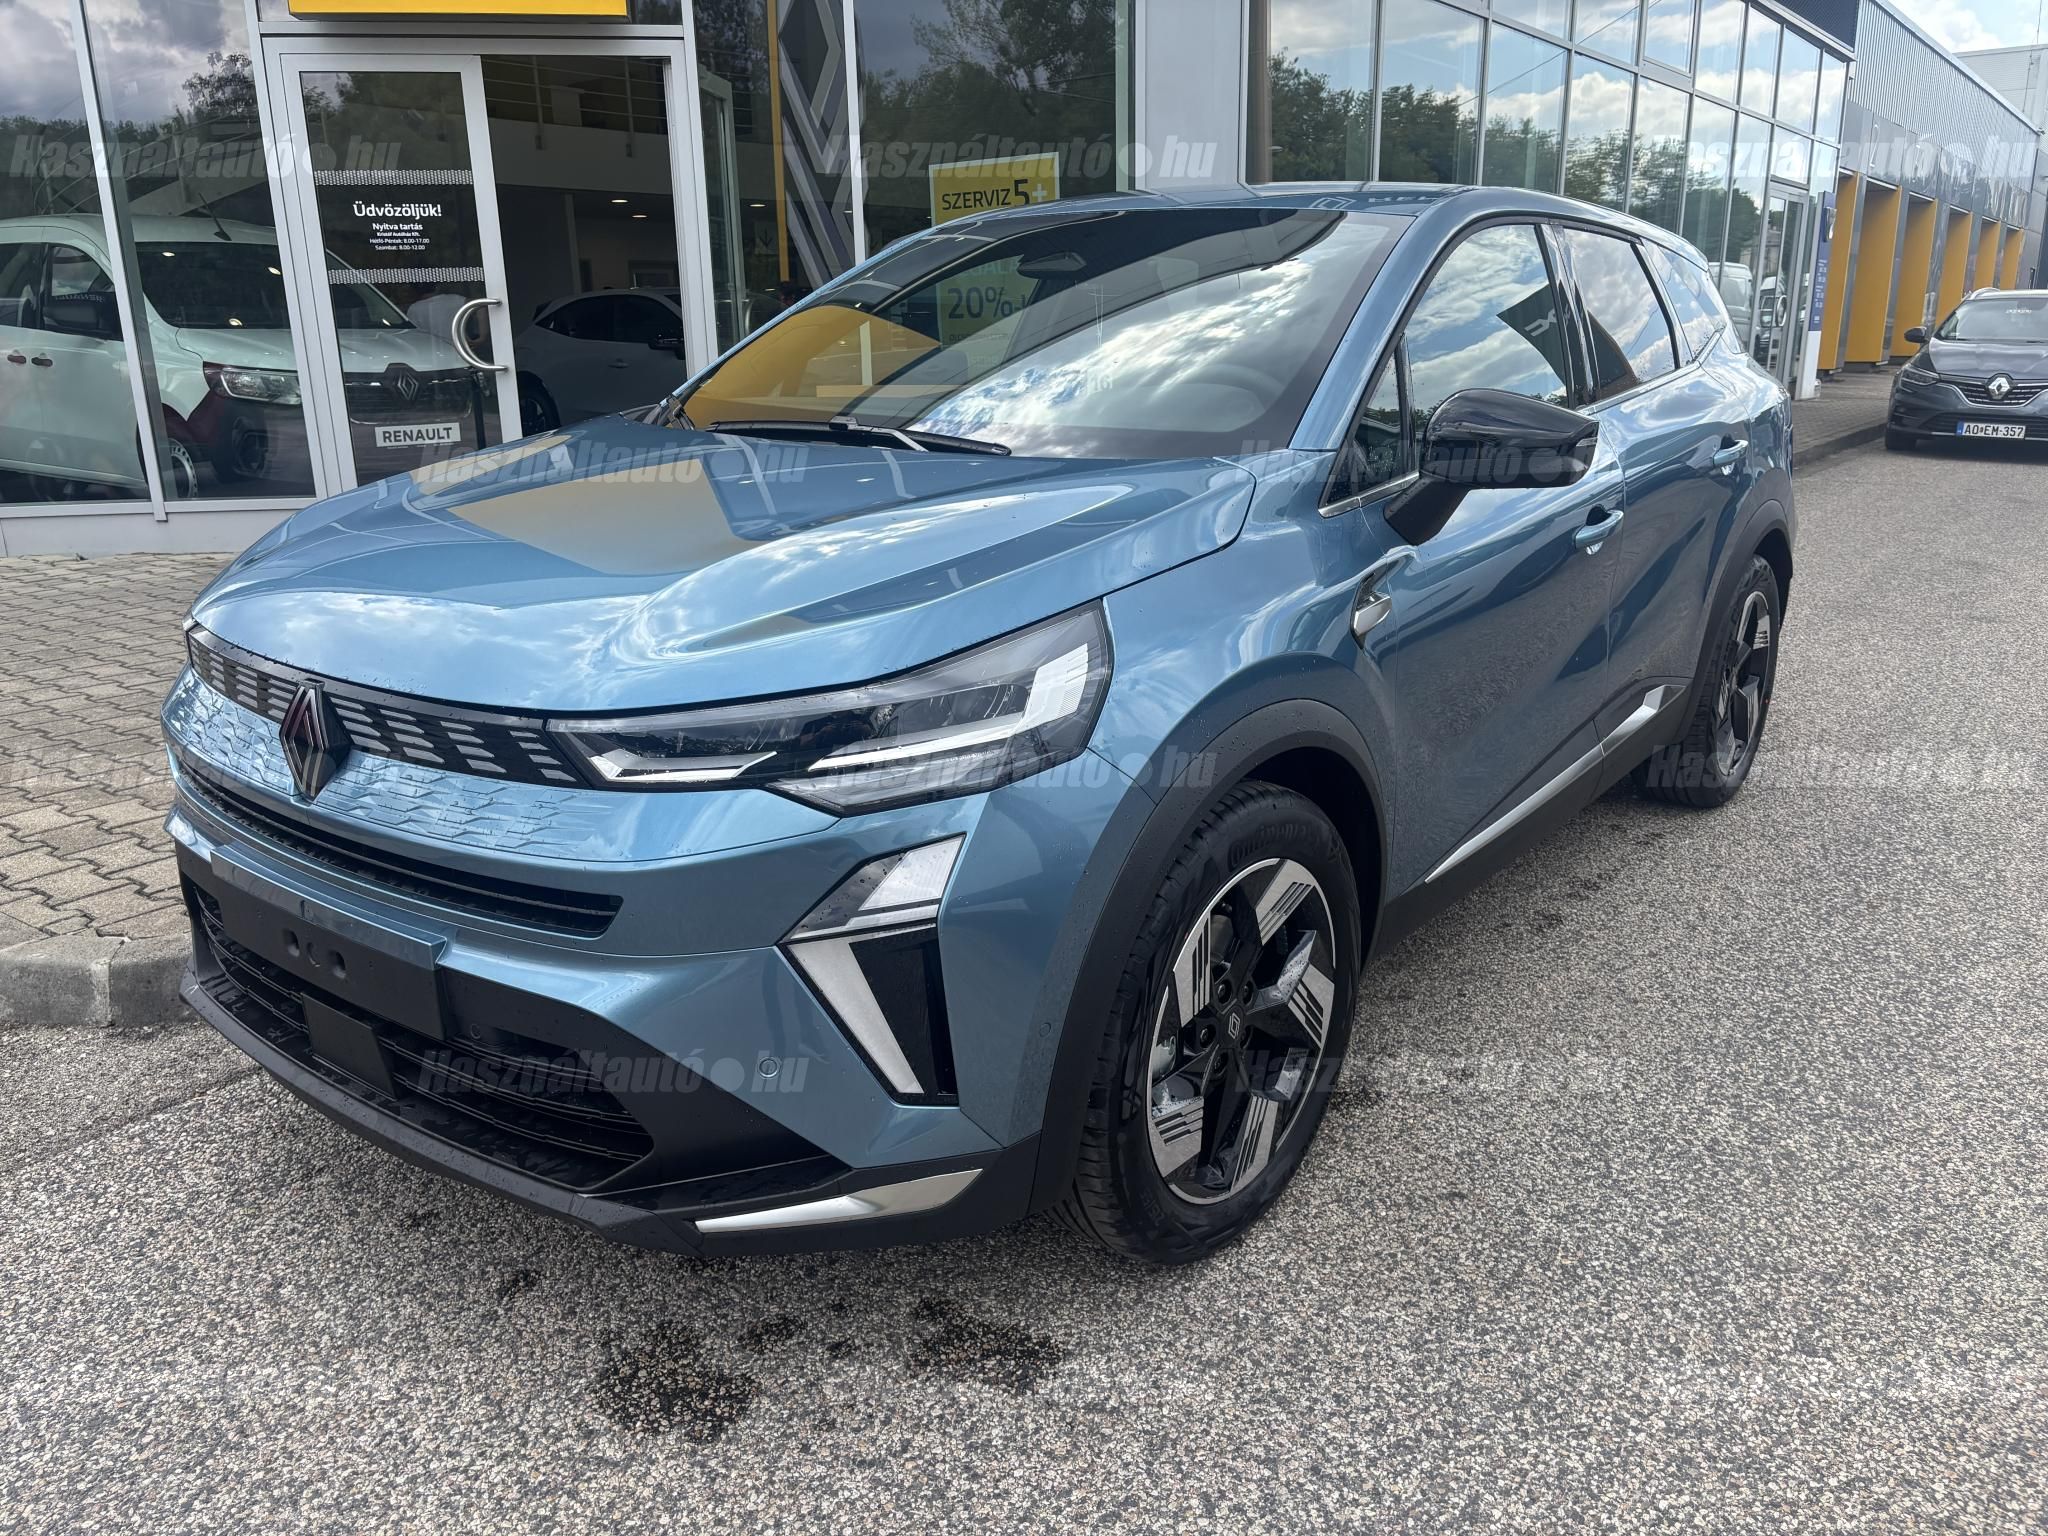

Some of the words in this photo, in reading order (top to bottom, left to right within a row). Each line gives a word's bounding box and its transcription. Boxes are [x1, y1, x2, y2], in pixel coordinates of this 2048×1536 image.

[941, 188, 1012, 211] SZERVIZ
[352, 200, 443, 221] Üdvözöljük!
[372, 222, 399, 232] Nyitva
[399, 222, 424, 231] tartás
[381, 427, 453, 443] RENAULT
